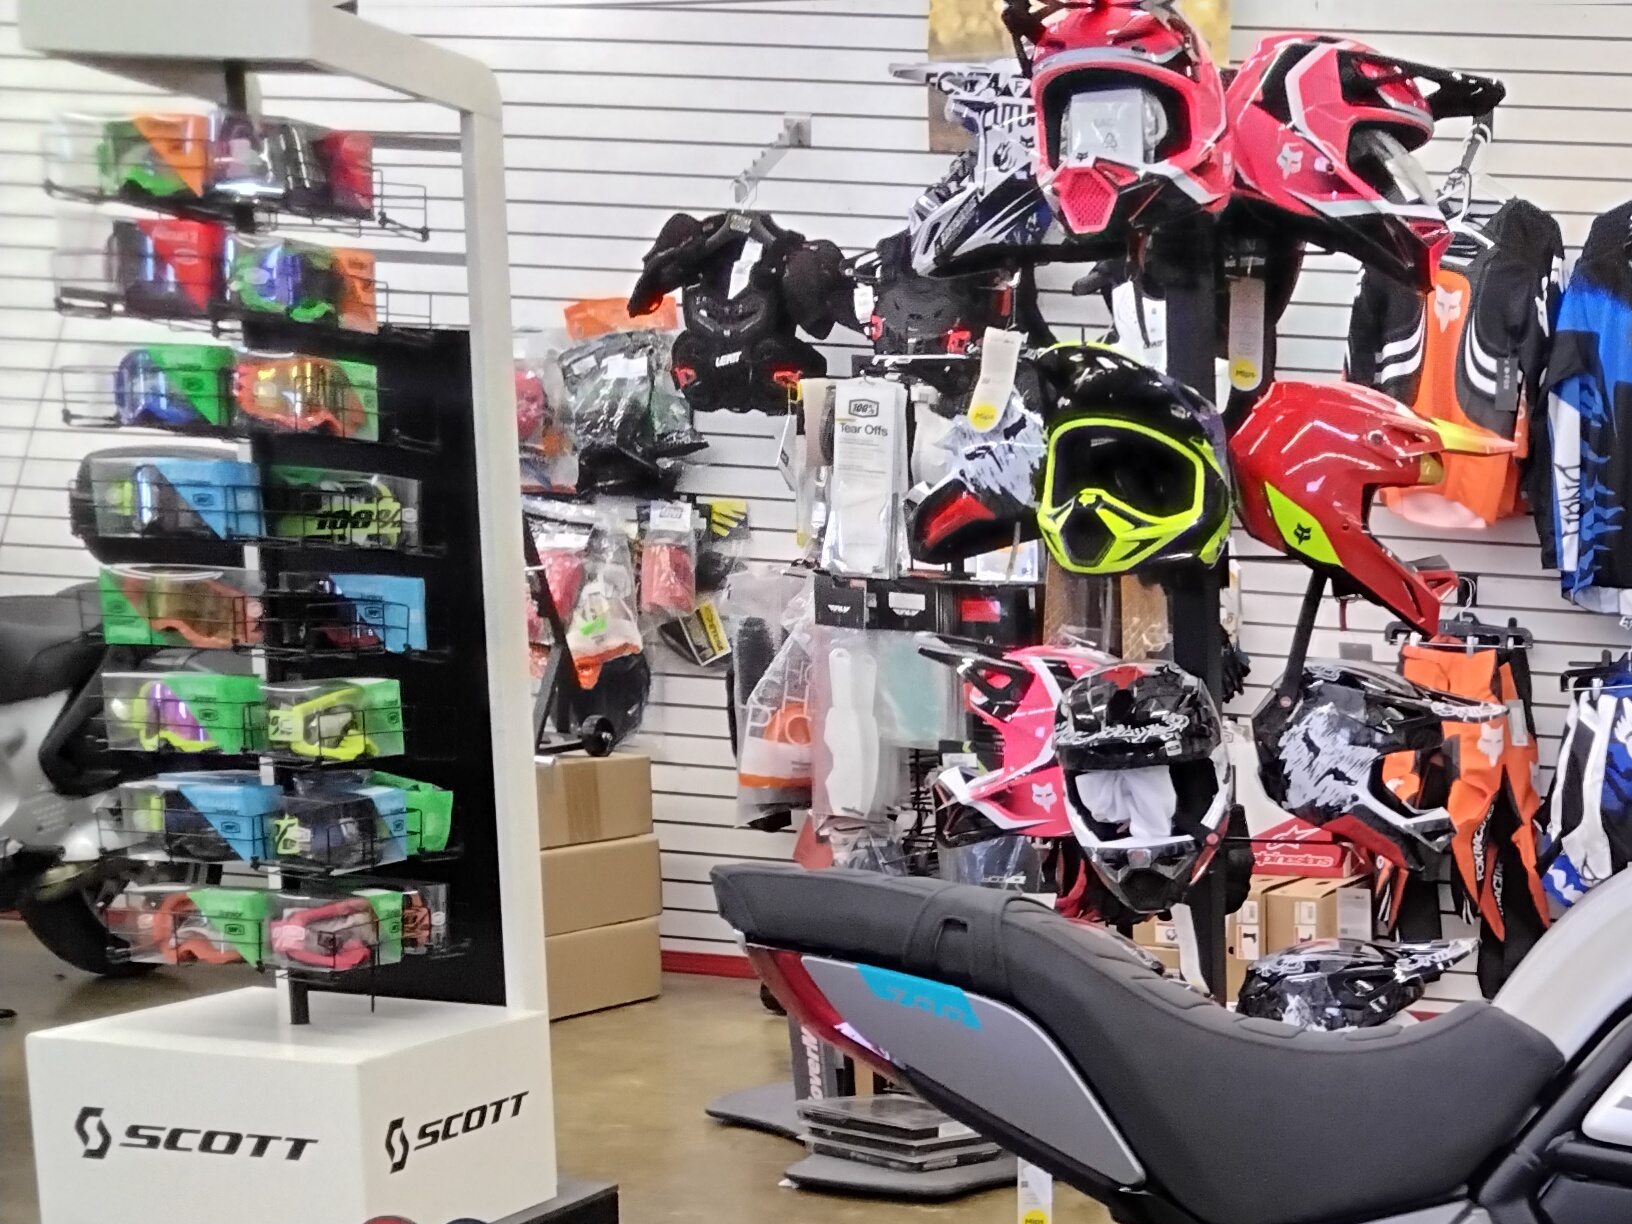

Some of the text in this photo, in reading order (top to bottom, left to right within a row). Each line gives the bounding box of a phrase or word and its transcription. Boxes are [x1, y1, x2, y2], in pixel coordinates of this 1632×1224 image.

[839, 422, 888, 437] Tear Offs
[413, 1090, 530, 1151] SCOTT
[119, 1124, 319, 1161] SCOTT
